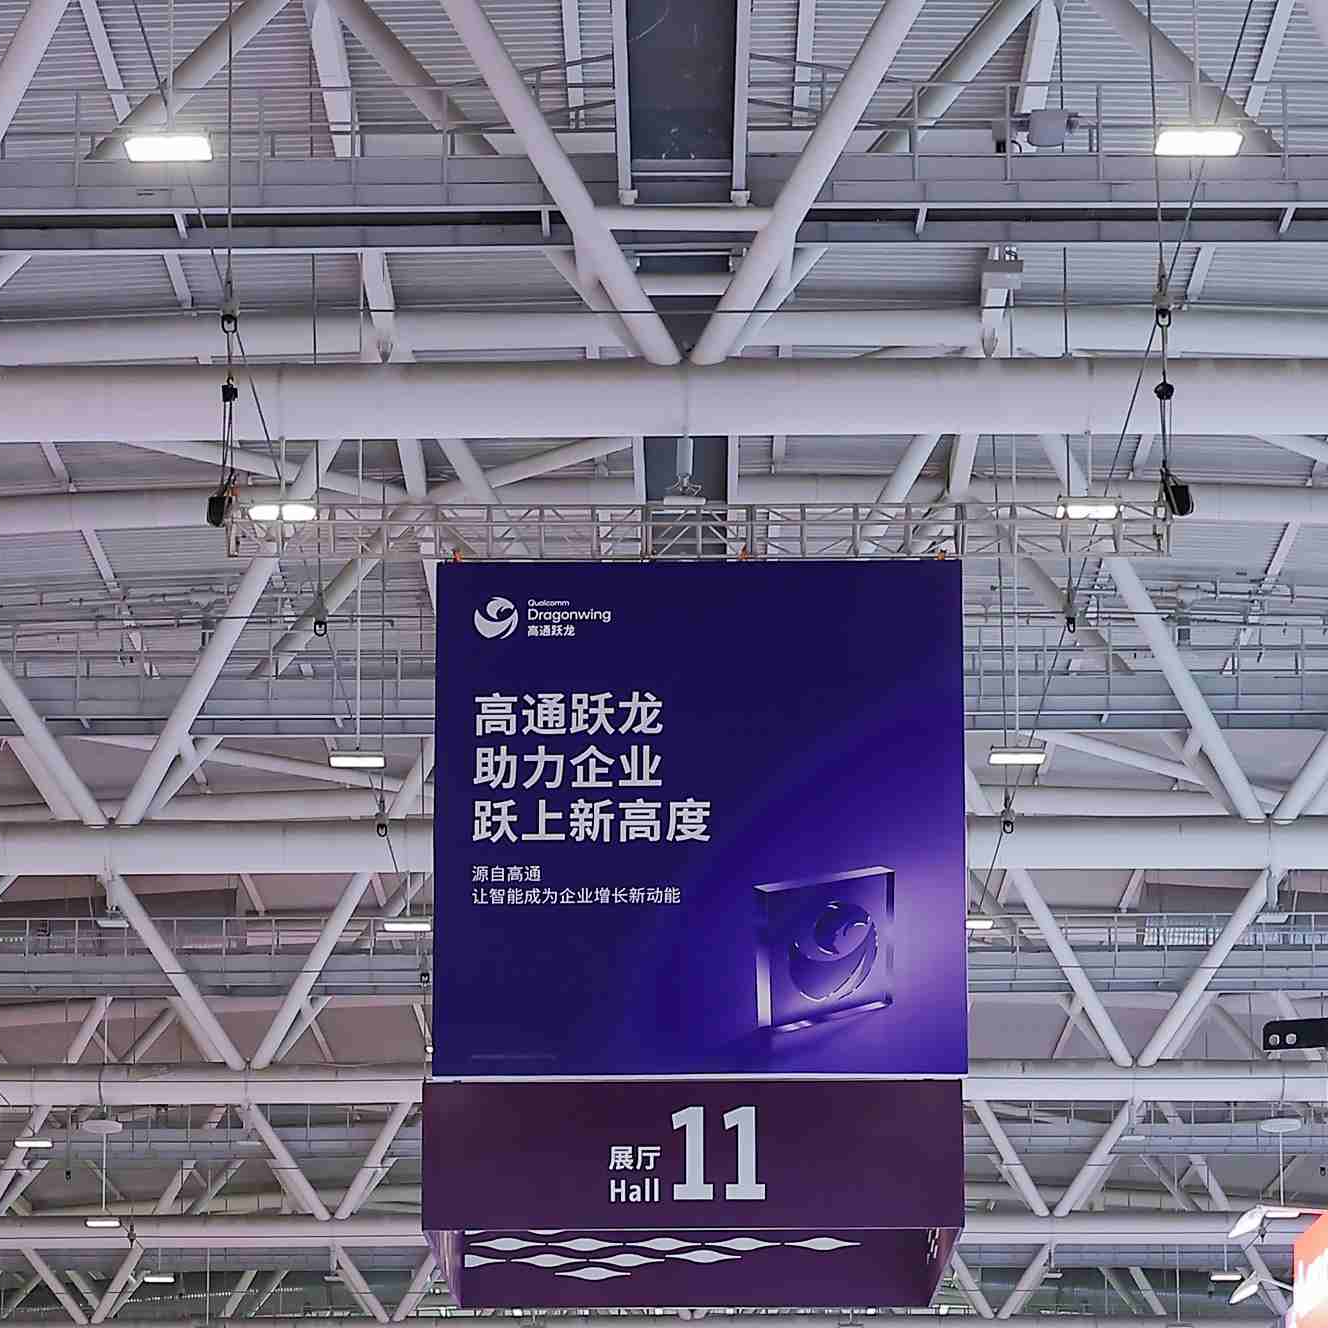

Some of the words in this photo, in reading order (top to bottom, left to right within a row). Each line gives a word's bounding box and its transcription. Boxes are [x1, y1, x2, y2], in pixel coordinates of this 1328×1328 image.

[527, 598, 570, 608] Qualcomm
[527, 608, 611, 624] Dragonwing
[527, 624, 576, 637] 高通跃龙
[474, 691, 664, 736] 高通跃龙
[473, 745, 663, 789] 助力企业
[472, 798, 711, 843] 跃上新高度
[472, 865, 542, 882] 源自高通
[472, 886, 681, 905] 让智能成为企业增长新动能
[608, 1145, 661, 1172] 展厅
[671, 1105, 767, 1201] 11
[609, 1177, 660, 1203] Hall
